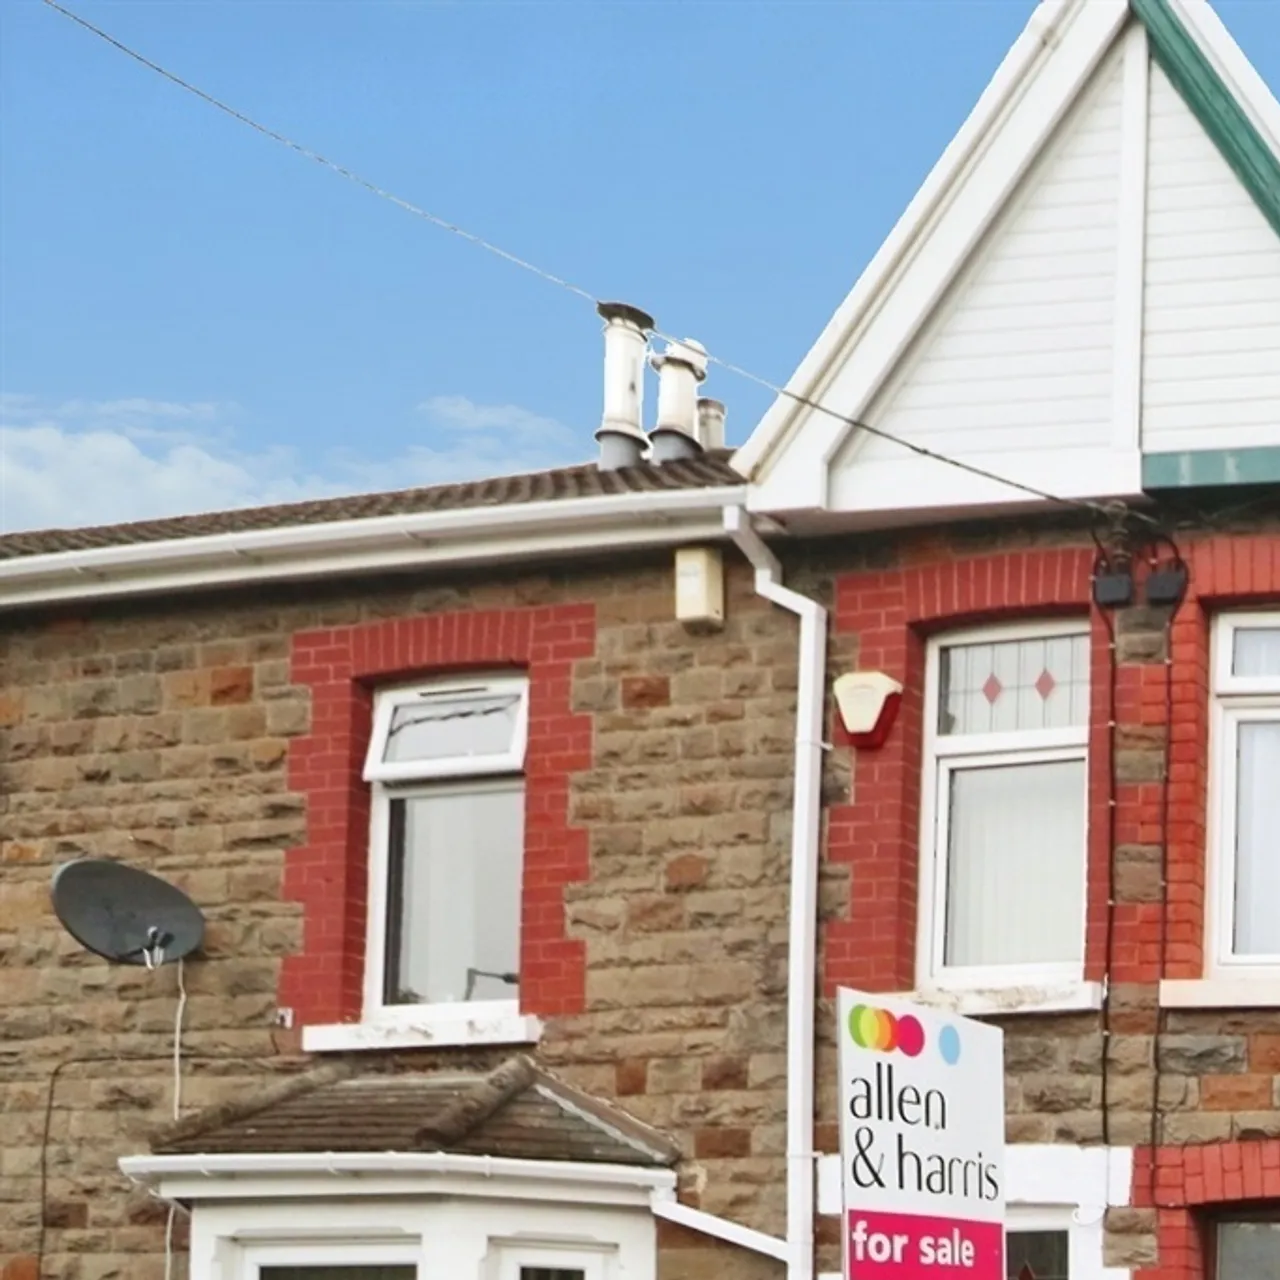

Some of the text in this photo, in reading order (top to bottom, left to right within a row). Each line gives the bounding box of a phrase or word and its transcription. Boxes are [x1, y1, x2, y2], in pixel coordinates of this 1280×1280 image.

[850, 1061, 946, 1130] allen
[852, 1126, 999, 1201] & harris
[852, 1220, 976, 1267] for sale
